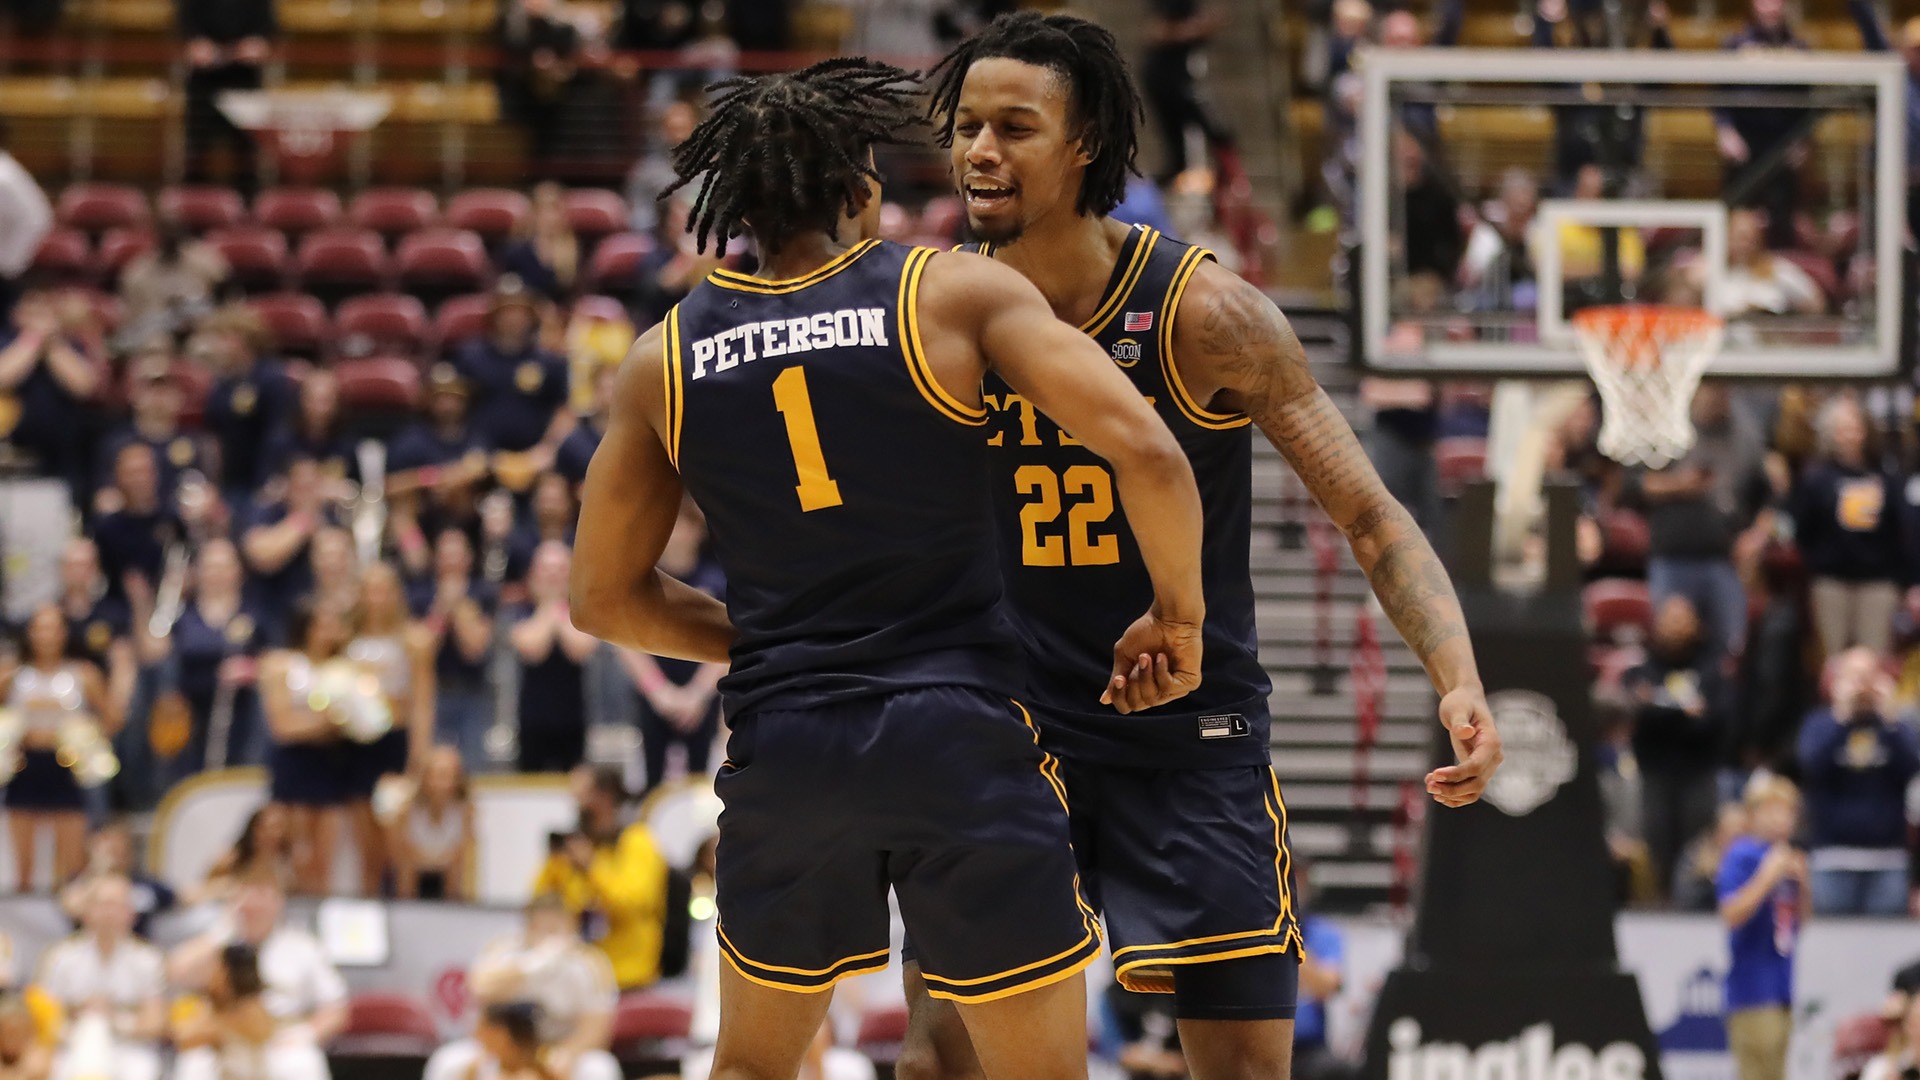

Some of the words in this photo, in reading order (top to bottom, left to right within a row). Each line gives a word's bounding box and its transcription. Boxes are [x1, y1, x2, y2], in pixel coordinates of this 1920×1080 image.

[691, 308, 889, 381] PETERSON
[772, 365, 844, 513] 1
[1014, 465, 1121, 567] 22
[1235, 719, 1243, 730] L
